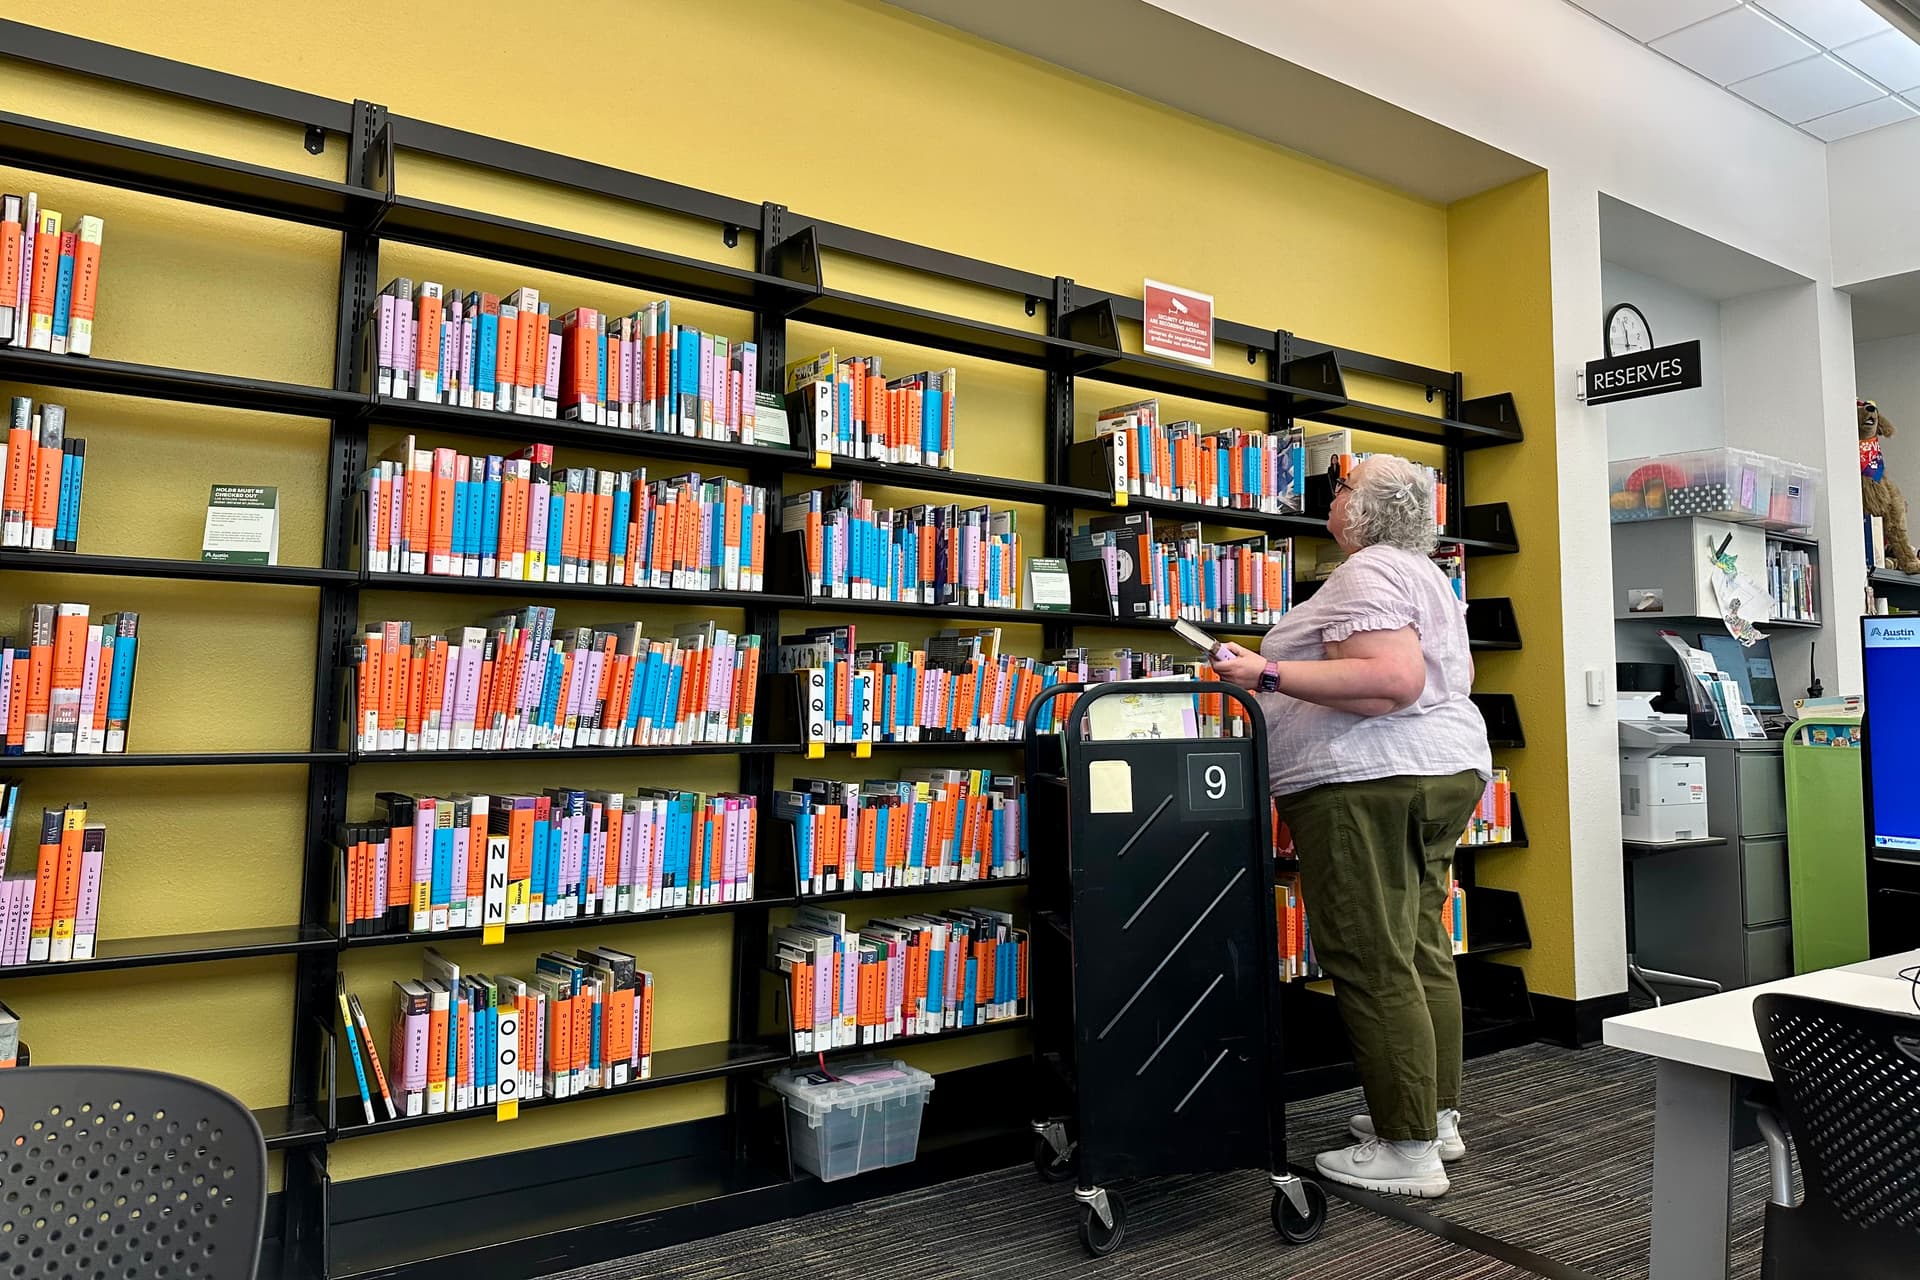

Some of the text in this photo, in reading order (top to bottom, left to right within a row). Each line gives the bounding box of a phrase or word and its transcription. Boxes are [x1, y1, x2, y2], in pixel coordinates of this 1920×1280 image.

[1158, 314, 1200, 329] SECURITY CAMERAS
[1594, 358, 1682, 390] RESERVES
[821, 386, 828, 446] P P P
[1118, 436, 1124, 486] S S S
[811, 674, 824, 736] Q Q Q
[1204, 765, 1227, 800] 9
[489, 844, 505, 918] N N N
